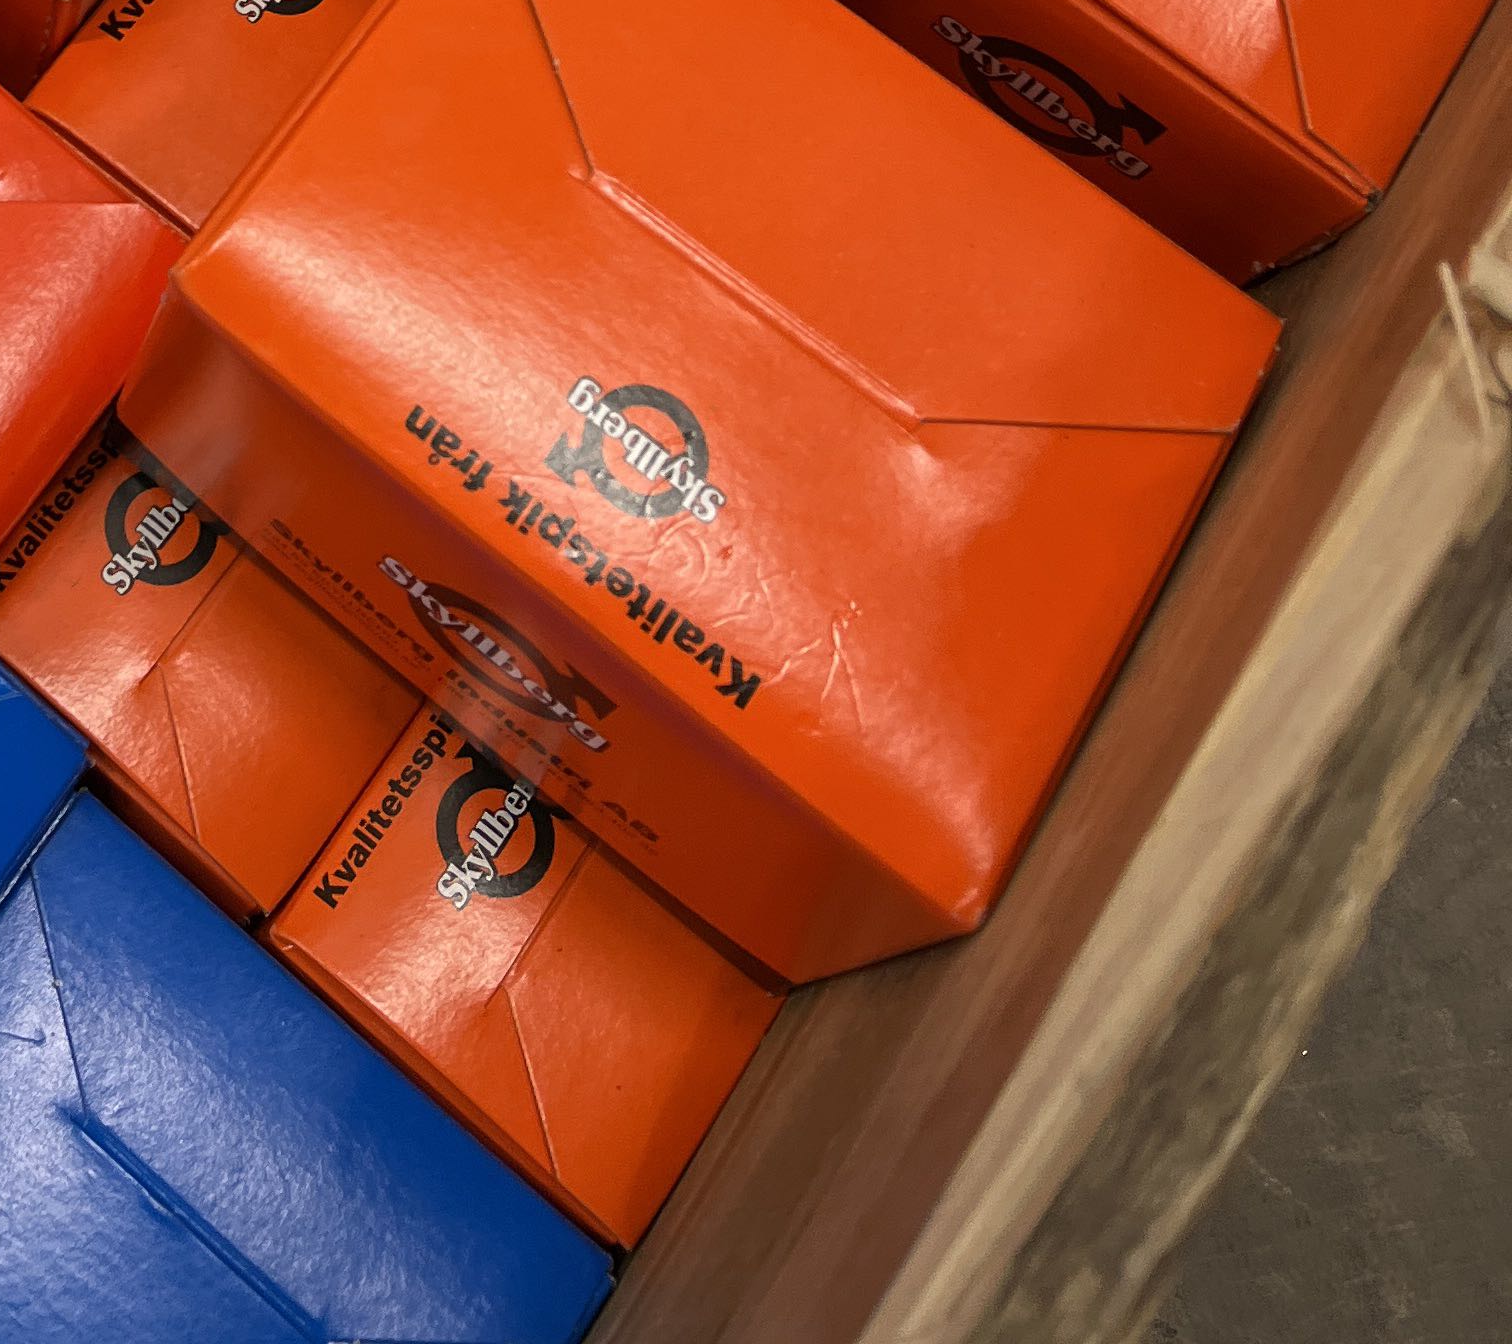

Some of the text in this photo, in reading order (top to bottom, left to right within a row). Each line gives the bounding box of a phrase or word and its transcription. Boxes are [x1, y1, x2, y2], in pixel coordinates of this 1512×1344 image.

[930, 15, 1151, 180] Skyllberg
[404, 404, 494, 495] från
[567, 375, 726, 525] Skyllberg
[376, 554, 610, 752] Skyllberg
[500, 483, 761, 710] Kvalitetspik
[313, 711, 454, 910] Kvalitetsspi
